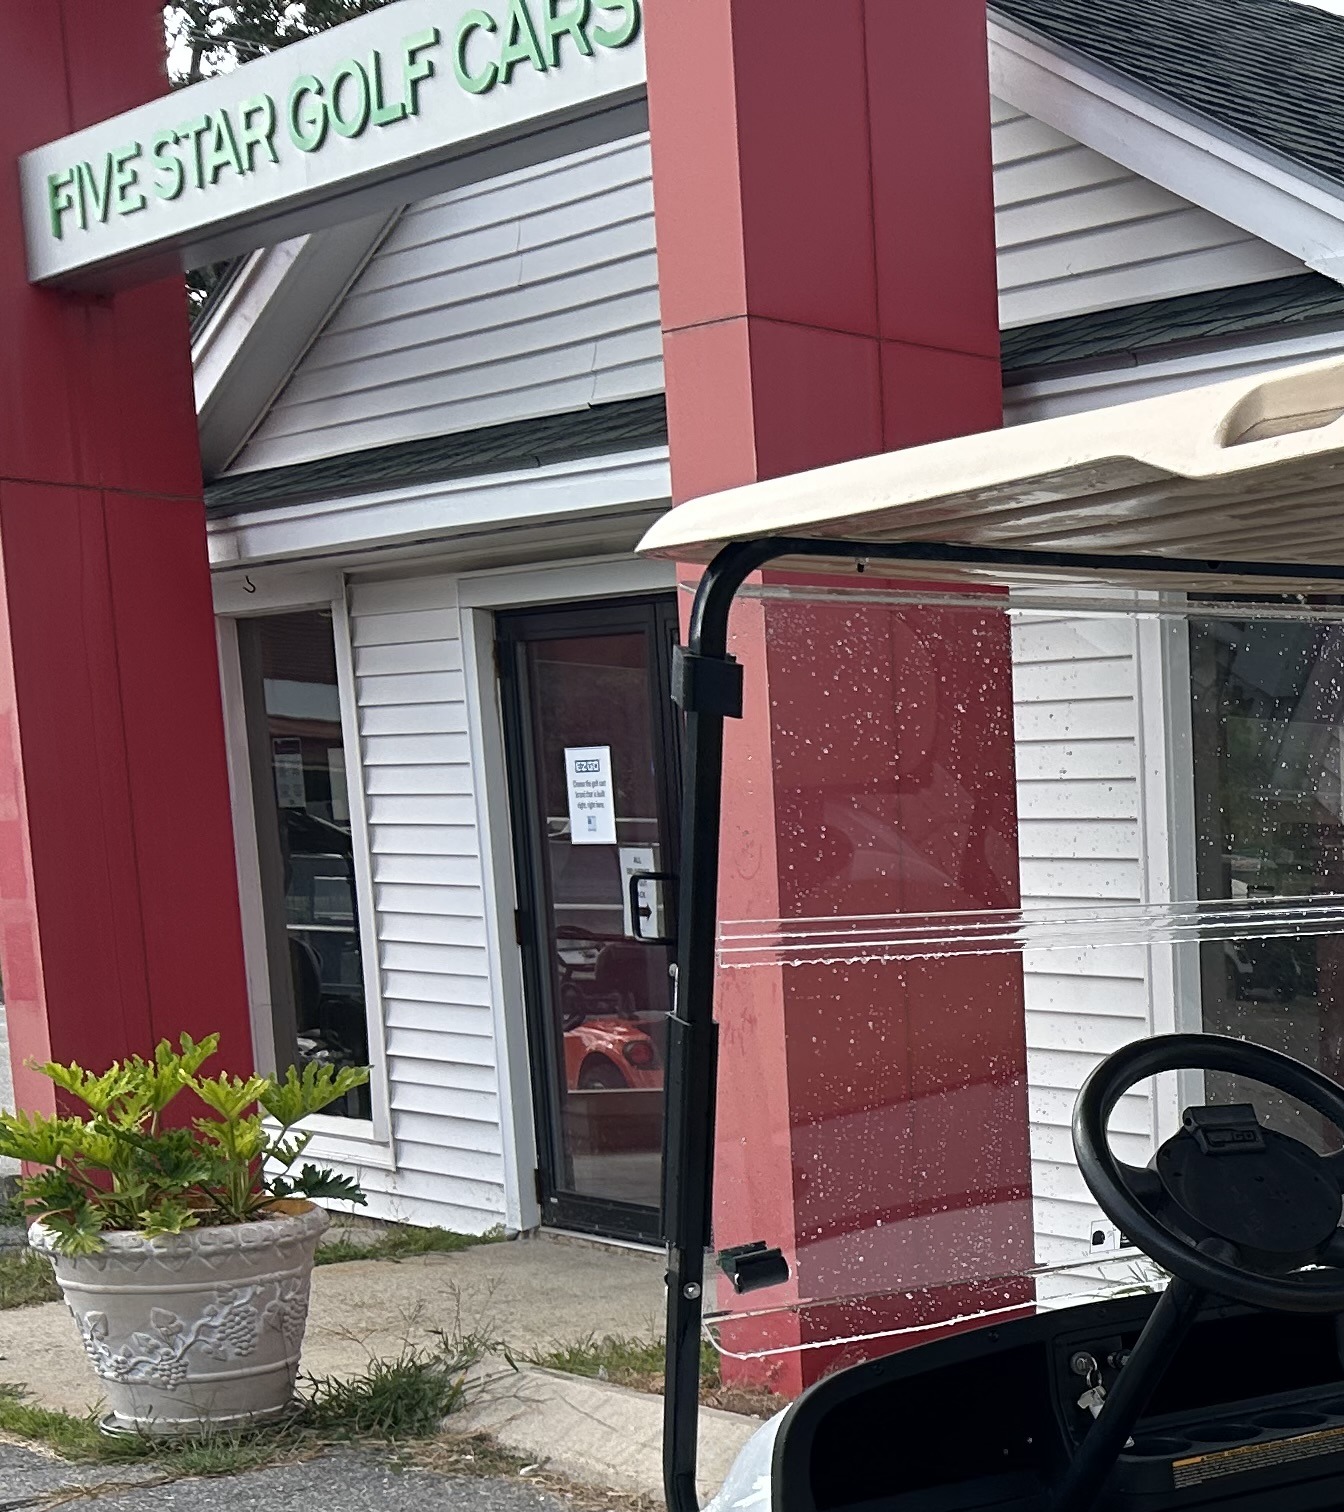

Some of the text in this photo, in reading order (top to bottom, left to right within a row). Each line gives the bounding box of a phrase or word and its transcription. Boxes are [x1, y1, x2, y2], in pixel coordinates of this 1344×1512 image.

[46, 0, 641, 239] FIVE STAR GOLF CARS
